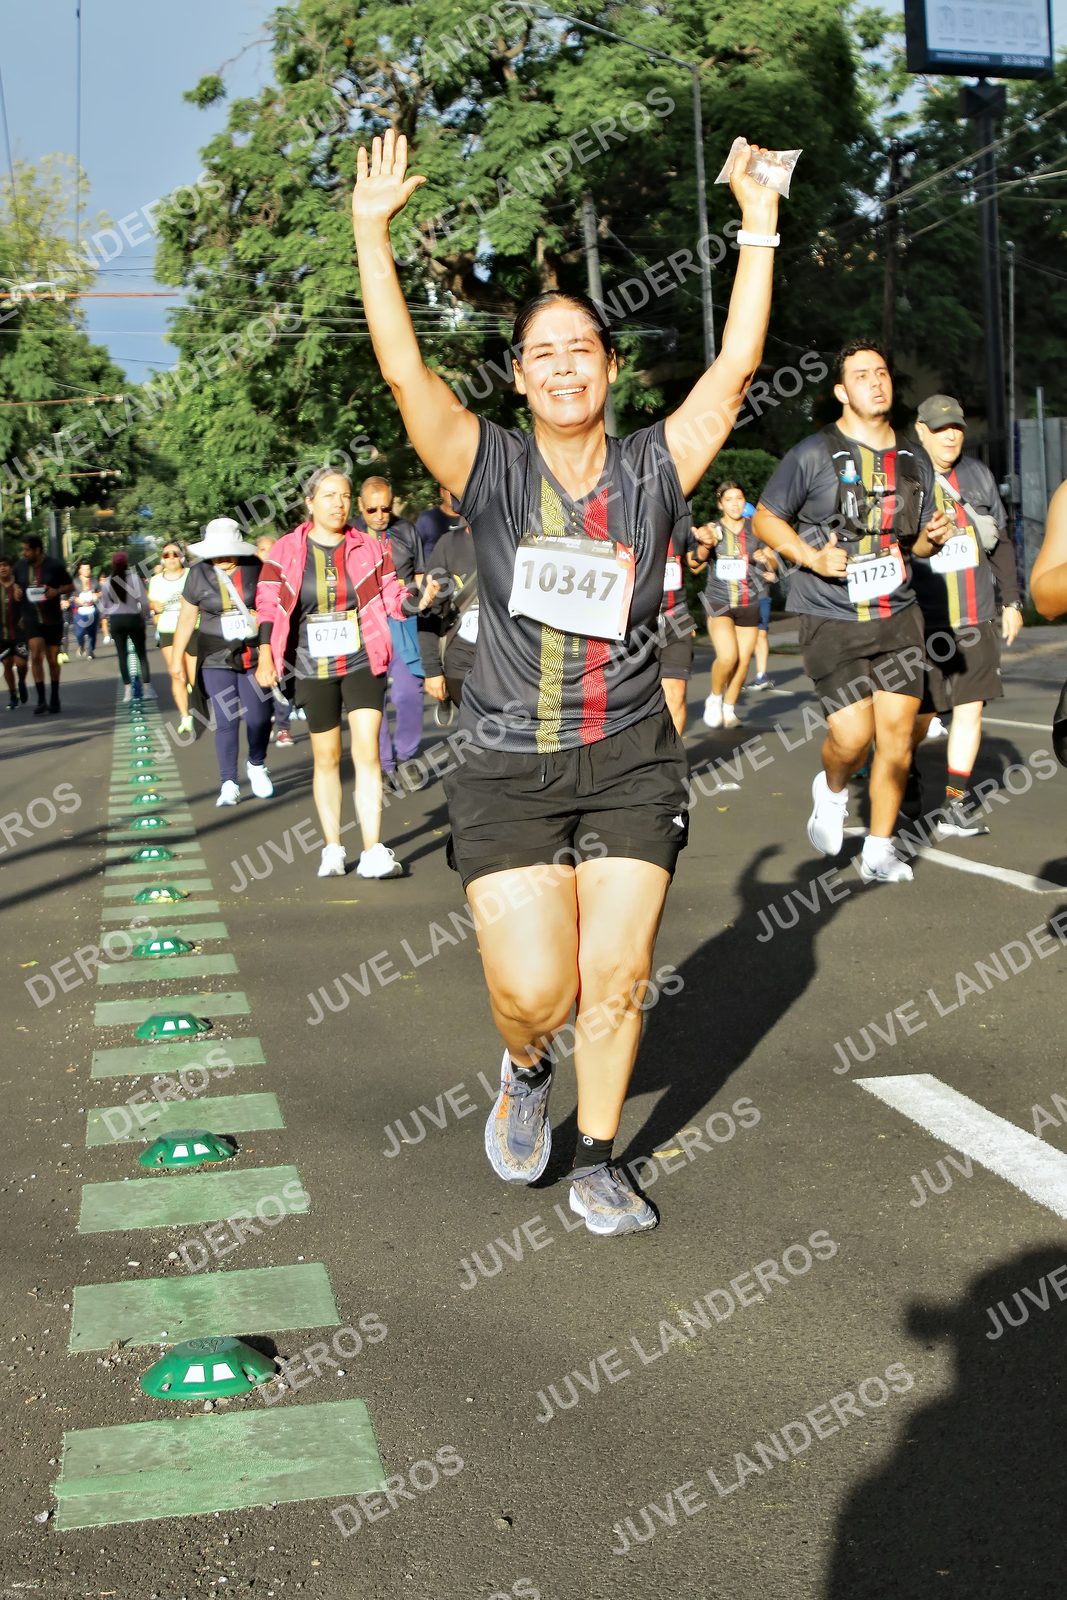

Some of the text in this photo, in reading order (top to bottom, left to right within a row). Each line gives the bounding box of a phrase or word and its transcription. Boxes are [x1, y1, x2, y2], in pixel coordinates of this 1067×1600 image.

[522, 560, 618, 601] 10347
[852, 562, 896, 585] 11723
[315, 626, 347, 642] 6774
